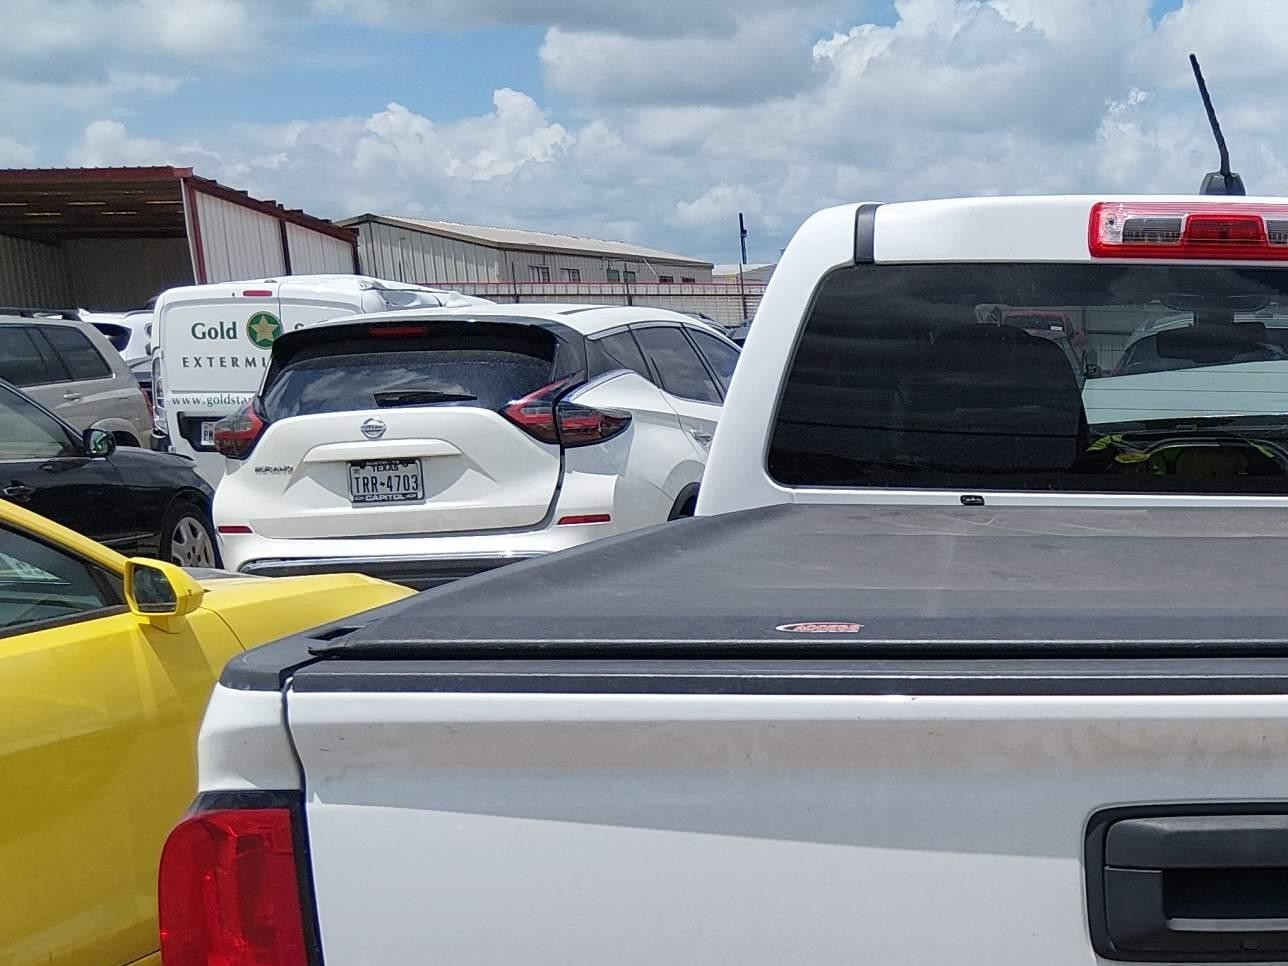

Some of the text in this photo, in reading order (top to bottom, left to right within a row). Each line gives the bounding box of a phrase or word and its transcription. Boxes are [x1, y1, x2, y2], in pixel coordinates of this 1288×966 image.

[191, 321, 237, 340] Gold
[182, 356, 267, 368] EXTERMI
[372, 463, 399, 472] TEXAS
